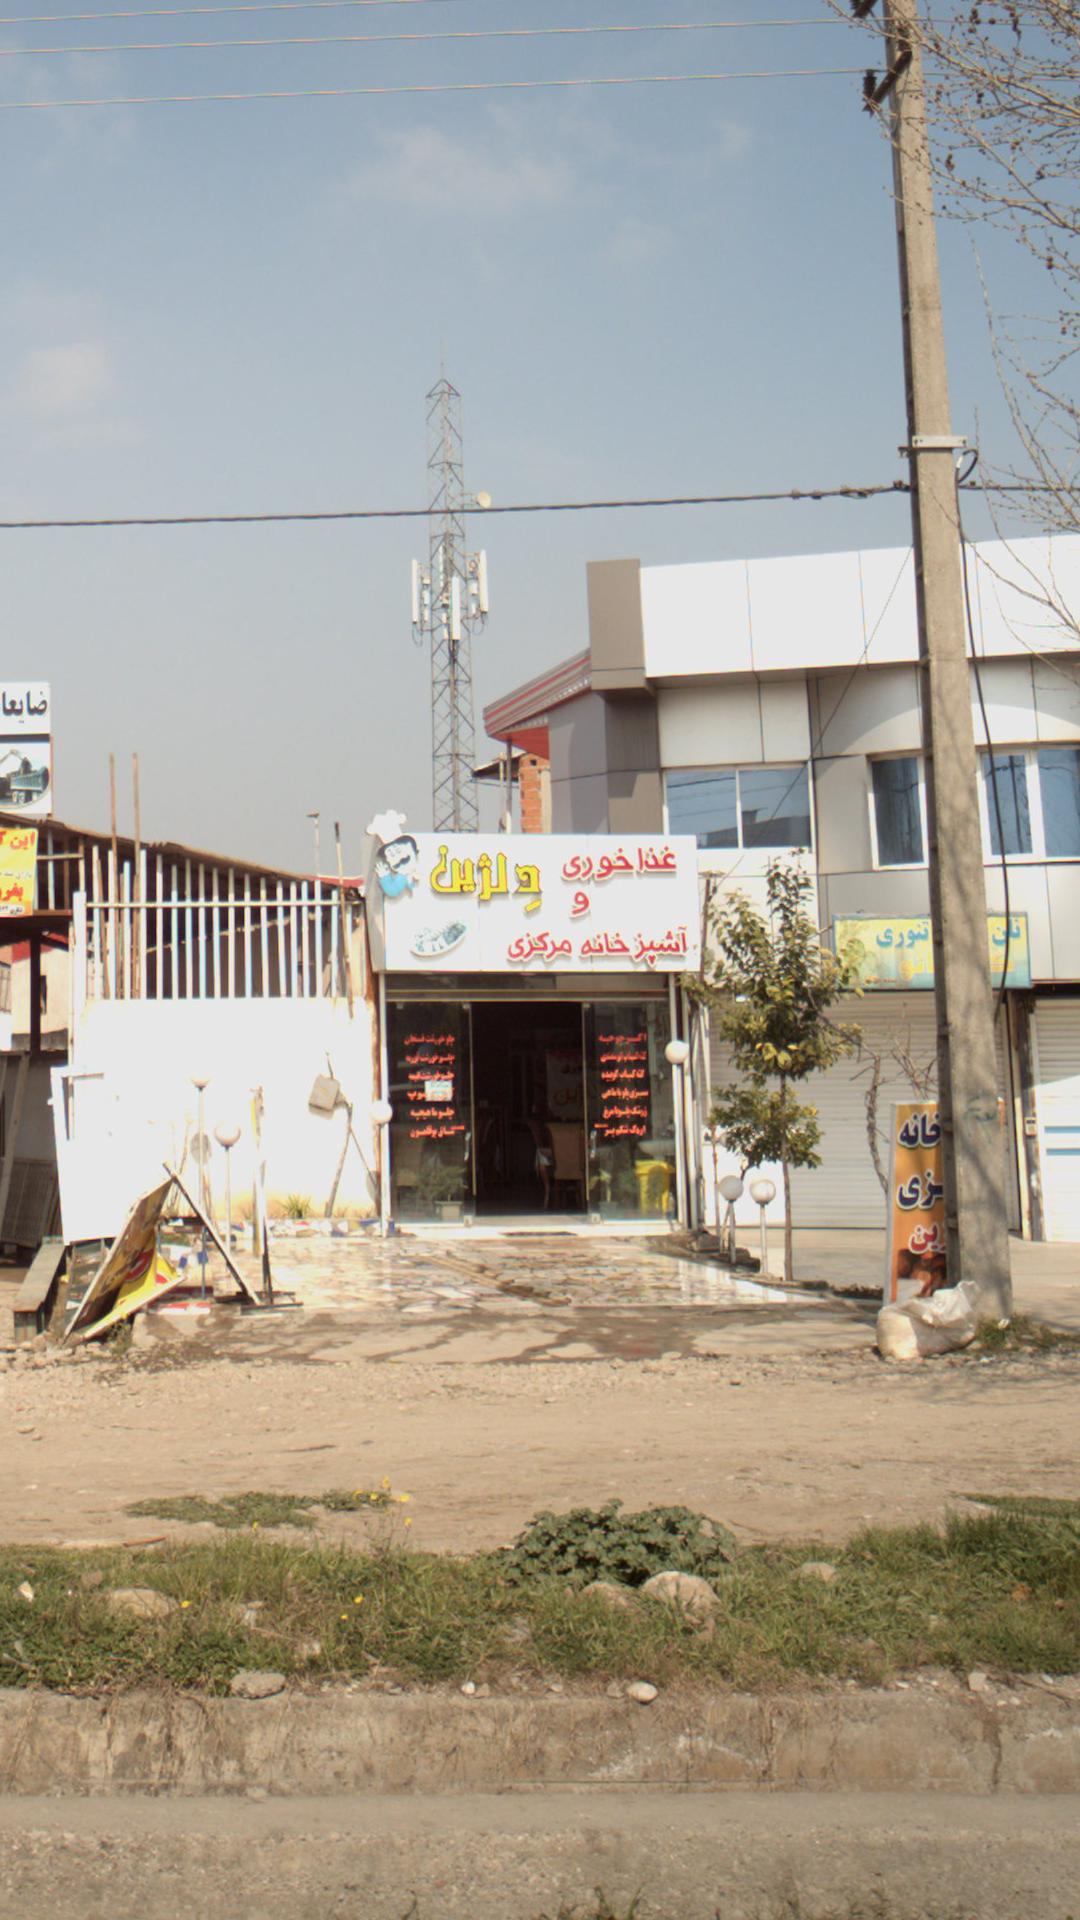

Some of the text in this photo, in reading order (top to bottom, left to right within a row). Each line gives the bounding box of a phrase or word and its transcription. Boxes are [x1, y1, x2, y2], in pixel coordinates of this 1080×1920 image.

[2, 691, 47, 724] ضایعا
[571, 890, 591, 915] و
[507, 931, 572, 960] مرکزی
